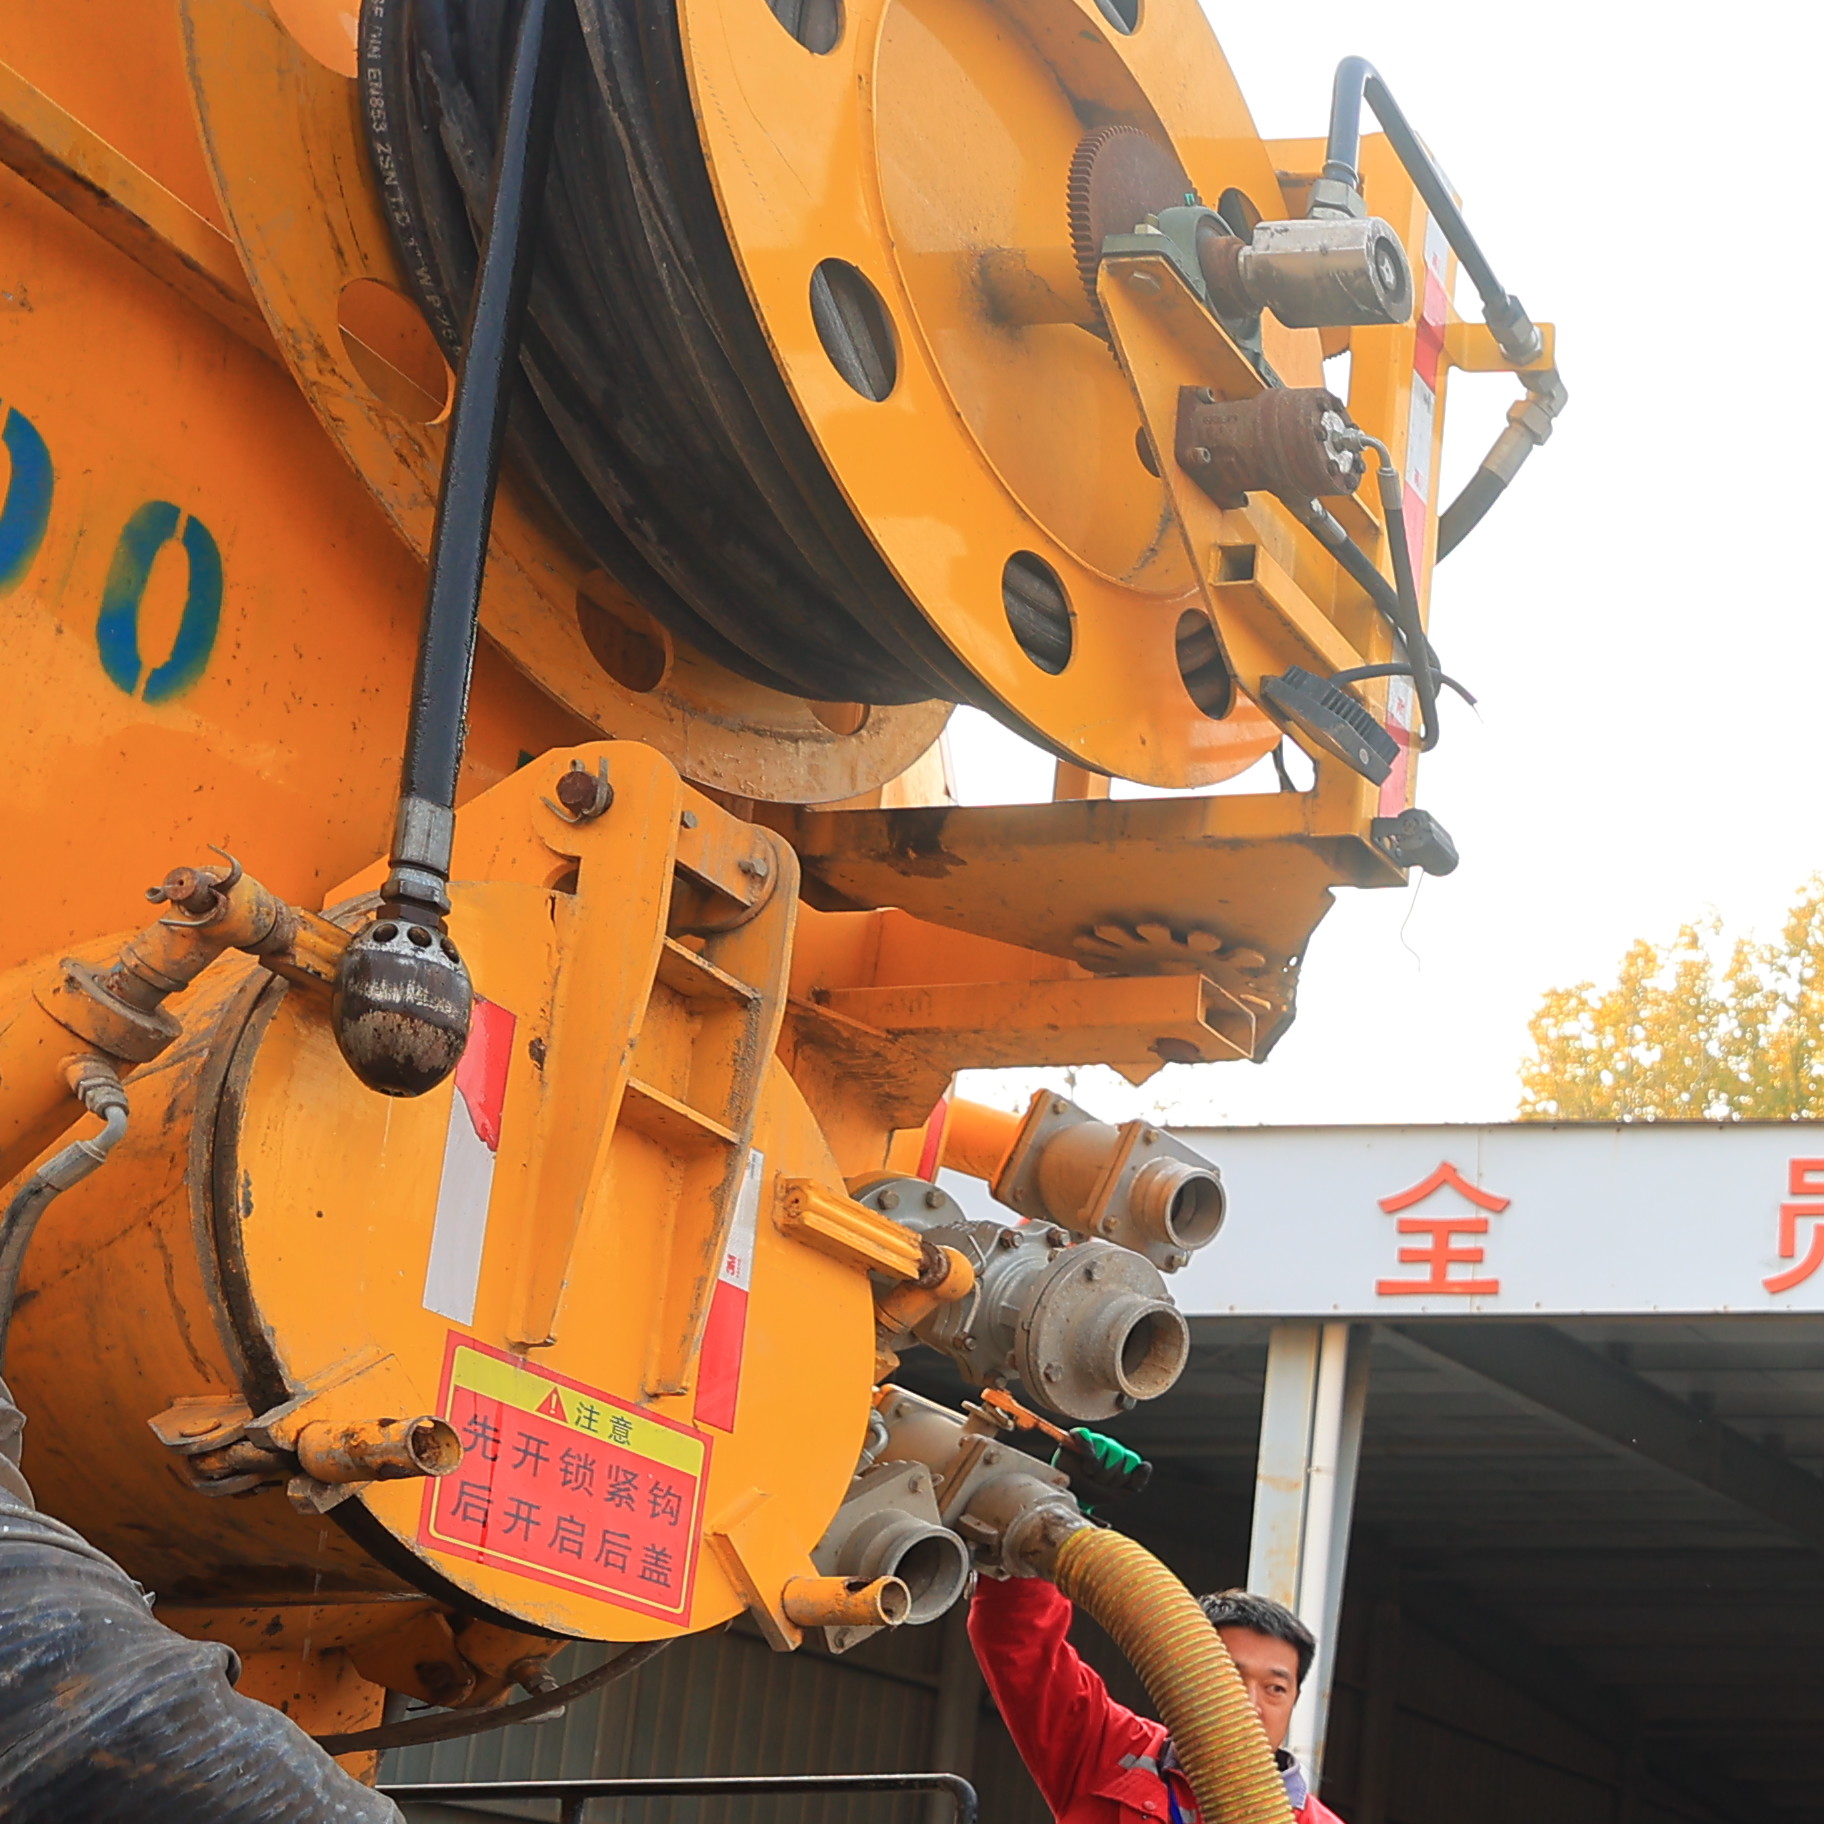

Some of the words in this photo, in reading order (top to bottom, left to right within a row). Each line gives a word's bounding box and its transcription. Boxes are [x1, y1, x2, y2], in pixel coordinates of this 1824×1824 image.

[462, 1412, 684, 1527] 先开锁紧钩
[575, 1400, 634, 1446] 注意
[451, 1480, 674, 1589] 后开启后盖
